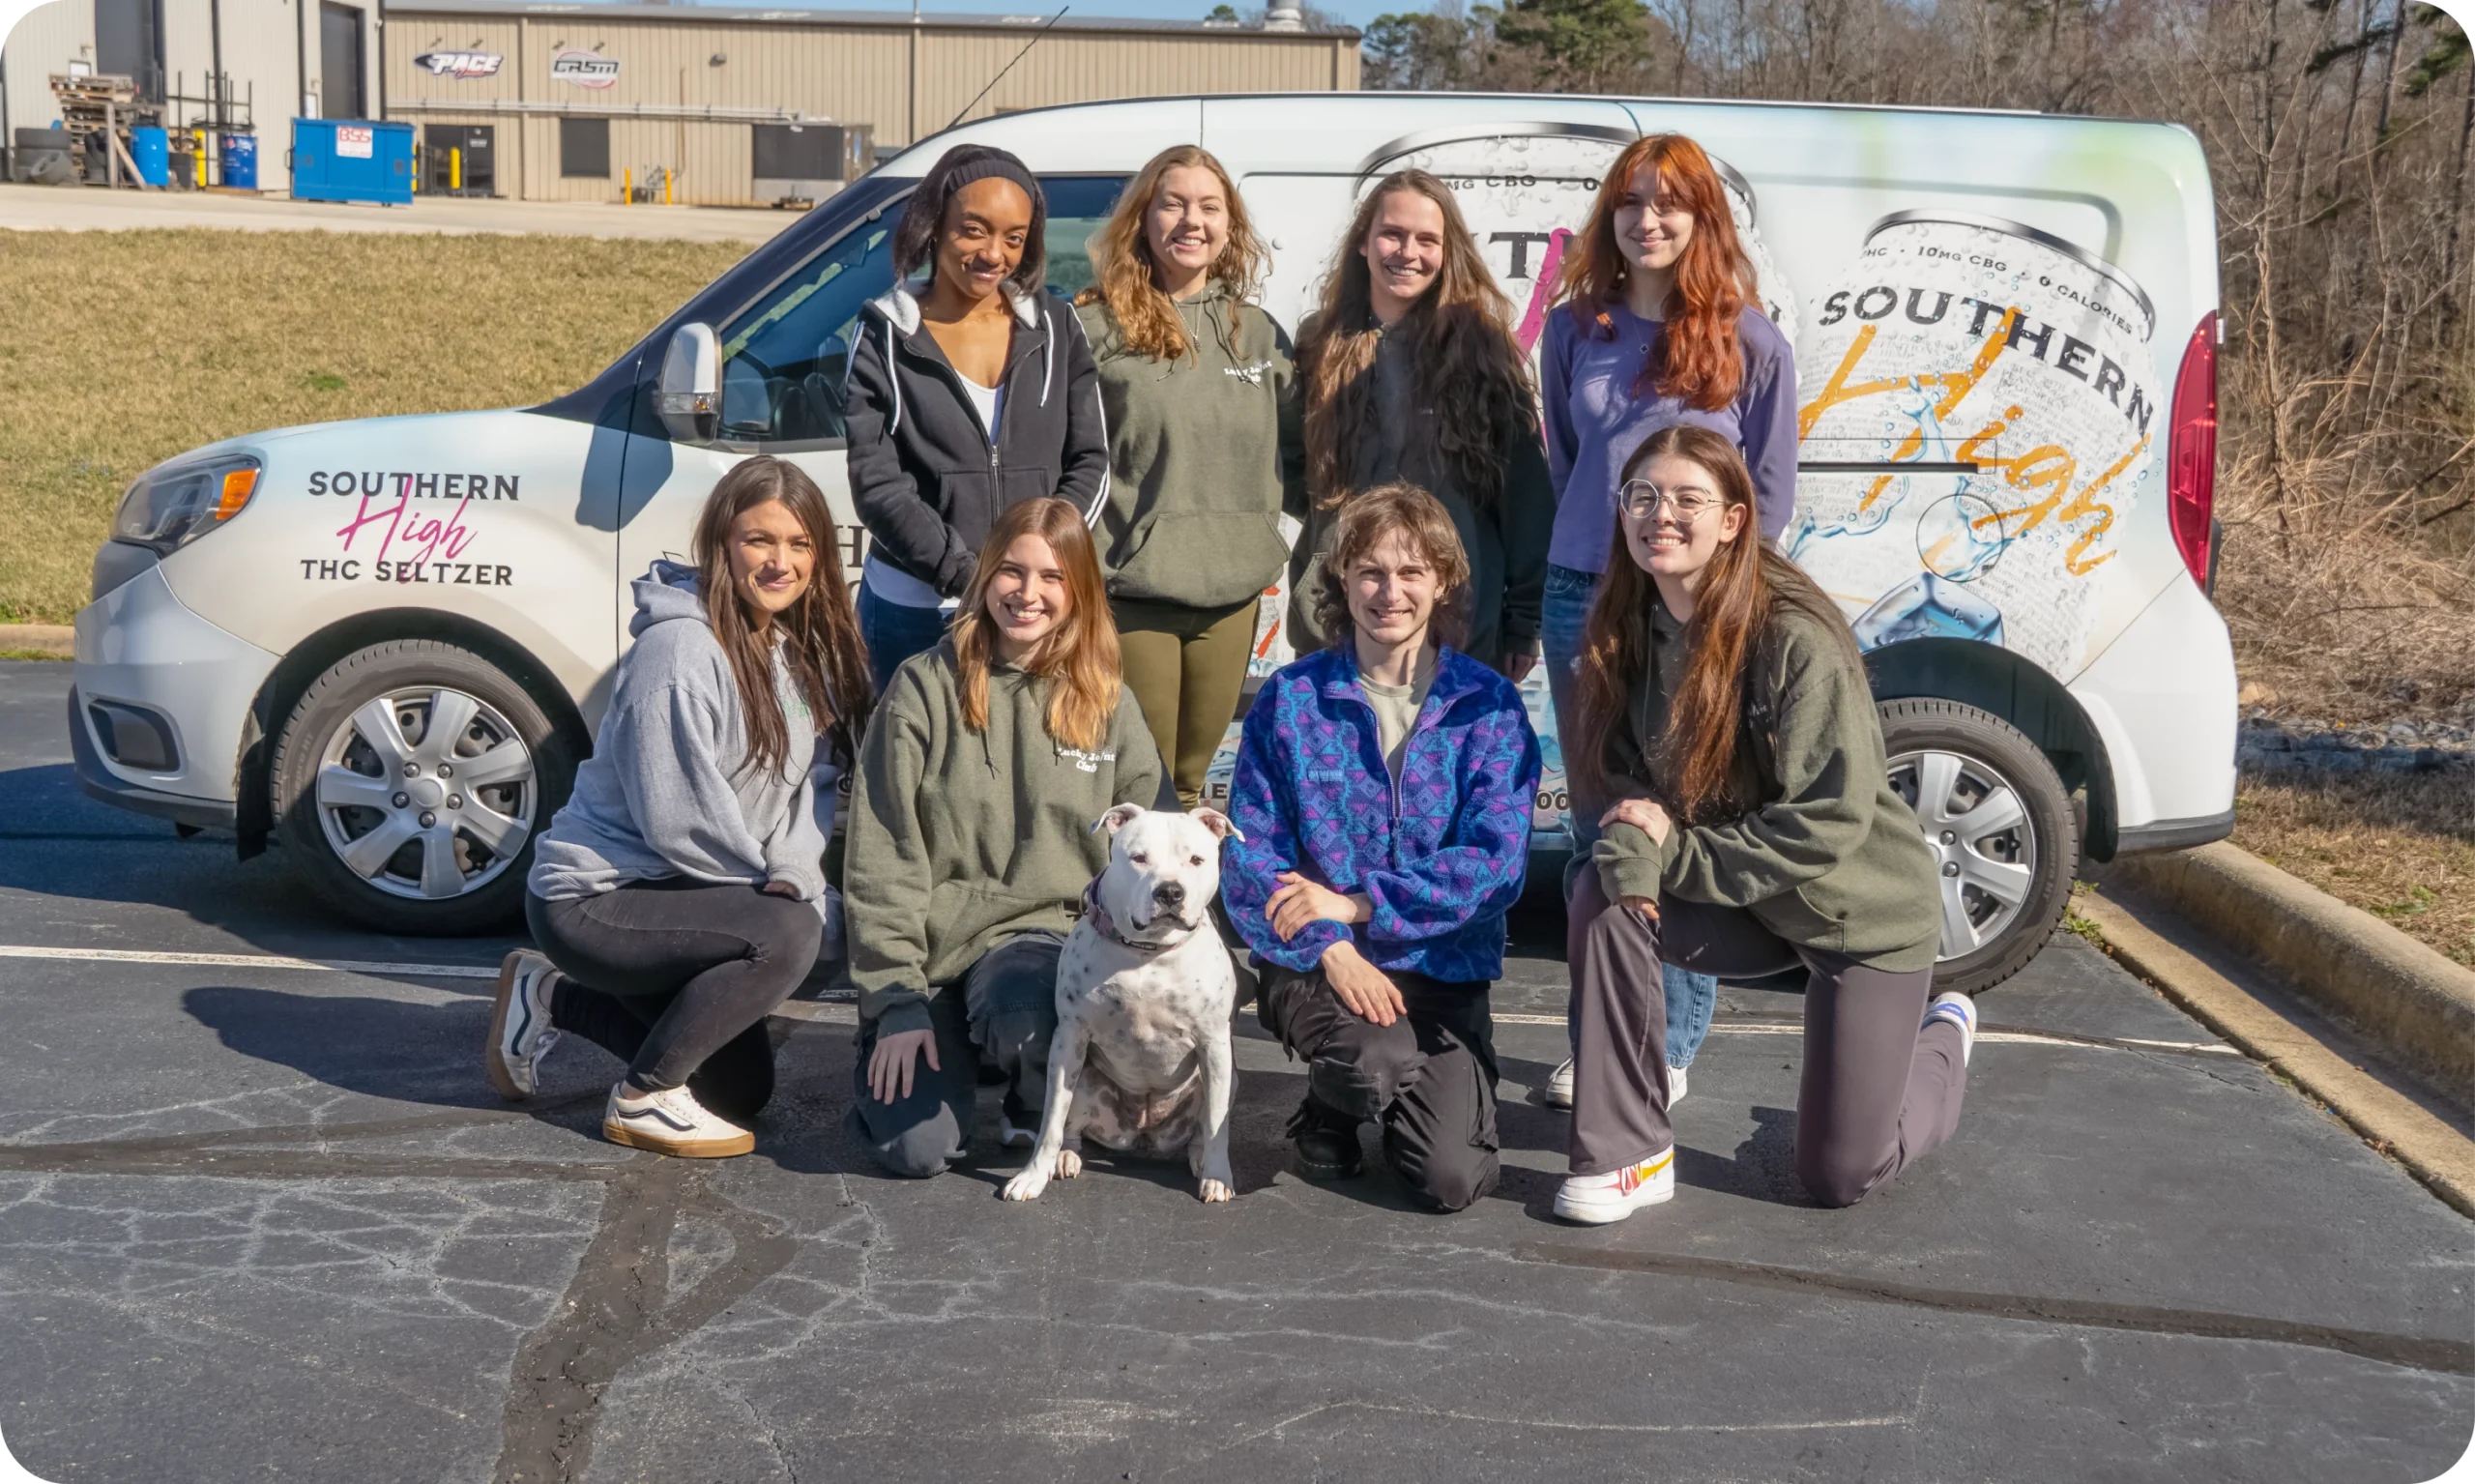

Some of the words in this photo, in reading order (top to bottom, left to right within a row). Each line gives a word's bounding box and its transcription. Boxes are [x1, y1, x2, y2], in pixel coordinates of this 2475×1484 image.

[433, 54, 503, 74] PACE
[1486, 175, 1537, 188] CBG
[1860, 247, 1888, 259] HC
[1918, 246, 1962, 261] 10MG
[1969, 255, 2008, 272] CBG
[2057, 284, 2133, 335] CALORIES
[1819, 285, 2154, 442] SOUTHERN
[1799, 306, 2152, 576] High
[307, 471, 521, 501] SOUTHERN
[336, 474, 479, 585] High
[301, 560, 361, 581] THC
[375, 560, 513, 586] SELTZER
[1076, 760, 1098, 772] Club
